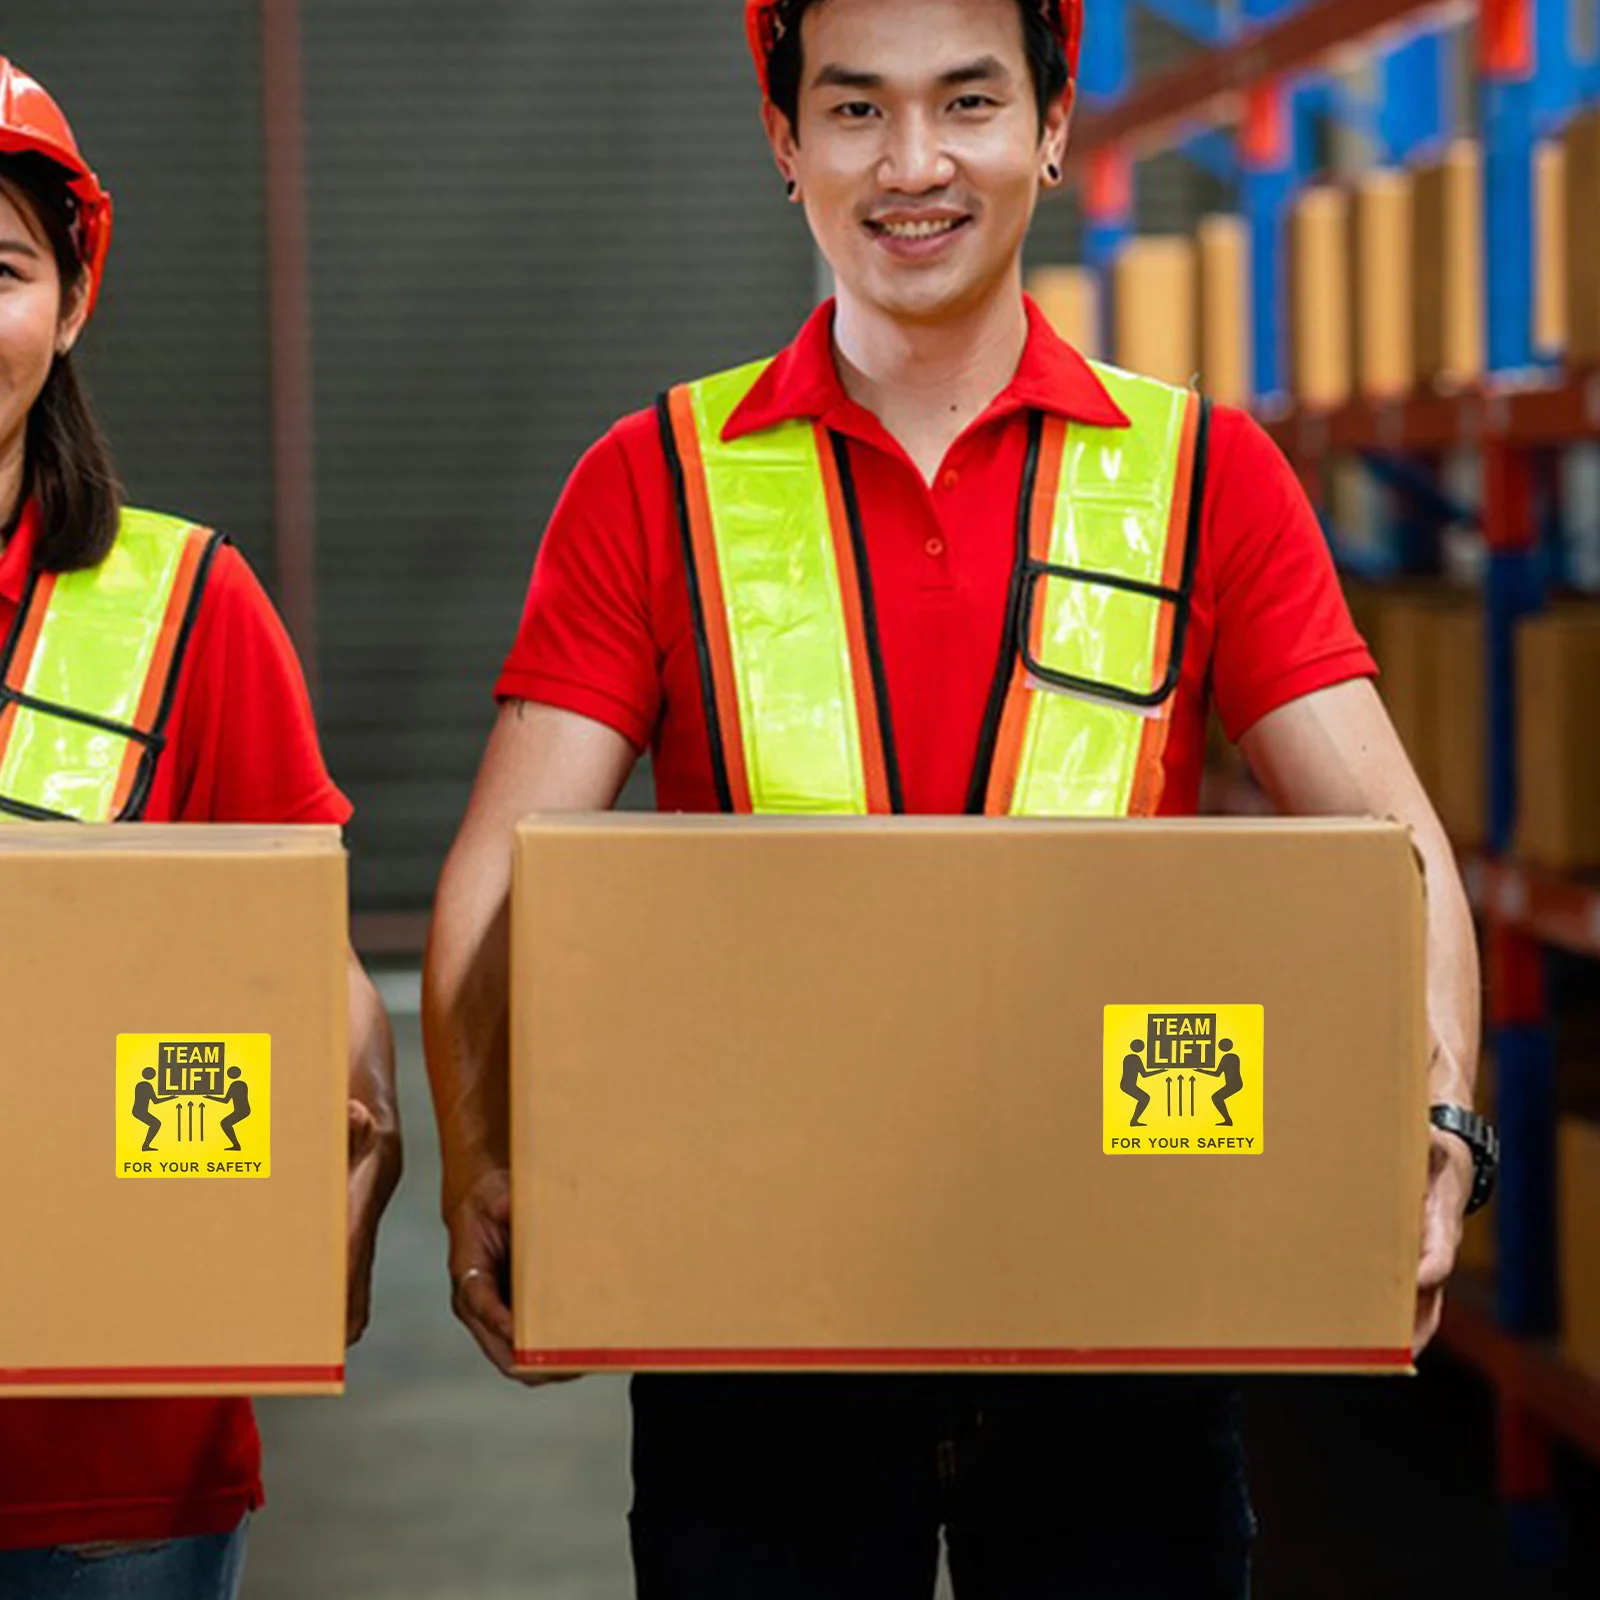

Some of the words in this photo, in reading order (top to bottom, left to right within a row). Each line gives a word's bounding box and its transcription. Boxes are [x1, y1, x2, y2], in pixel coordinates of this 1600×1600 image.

[1153, 1018, 1211, 1036] TEAM
[163, 1046, 219, 1064] TEAM
[1155, 1040, 1212, 1064] LIFT
[165, 1067, 220, 1091] LIFT
[1111, 1137, 1142, 1149] FOR
[1148, 1137, 1190, 1149] YOUR
[1197, 1137, 1255, 1149] SAFETY
[124, 1162, 153, 1173] FOR
[159, 1162, 200, 1173] YOUR
[206, 1161, 262, 1173] SAFETY
